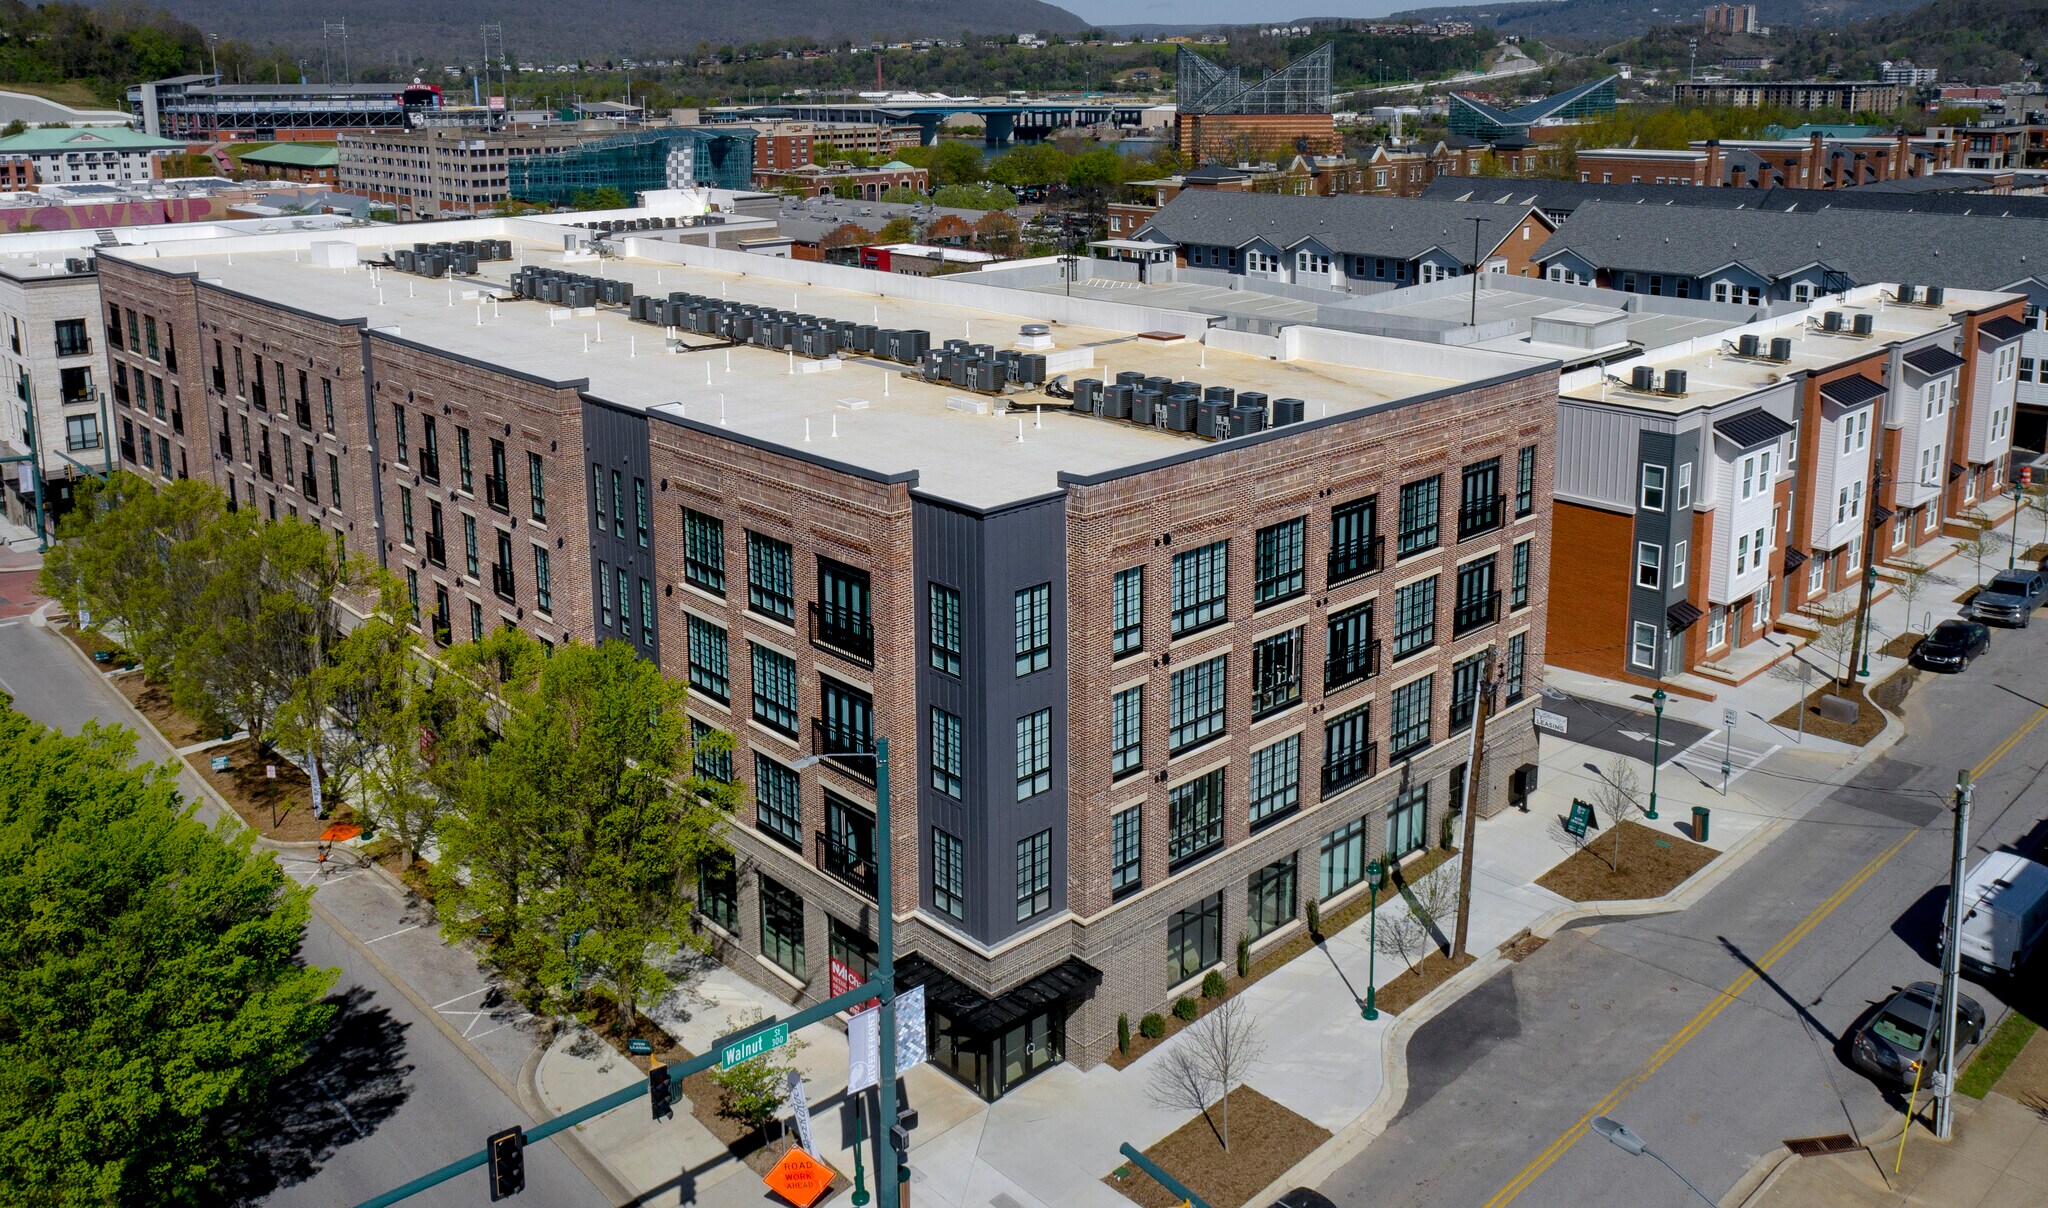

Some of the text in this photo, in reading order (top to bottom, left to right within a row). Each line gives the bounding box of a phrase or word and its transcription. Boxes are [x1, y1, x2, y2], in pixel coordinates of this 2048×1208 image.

[417, 83, 431, 91] FIELD
[1536, 718, 1565, 732] LEASING
[771, 1035, 784, 1047] 300
[726, 1028, 781, 1066] Walnut St
[867, 1011, 876, 1083] RIVERFRONT
[784, 1161, 813, 1170] ROAD
[785, 1172, 812, 1181] WORK
[786, 1181, 814, 1190] AHEAD
